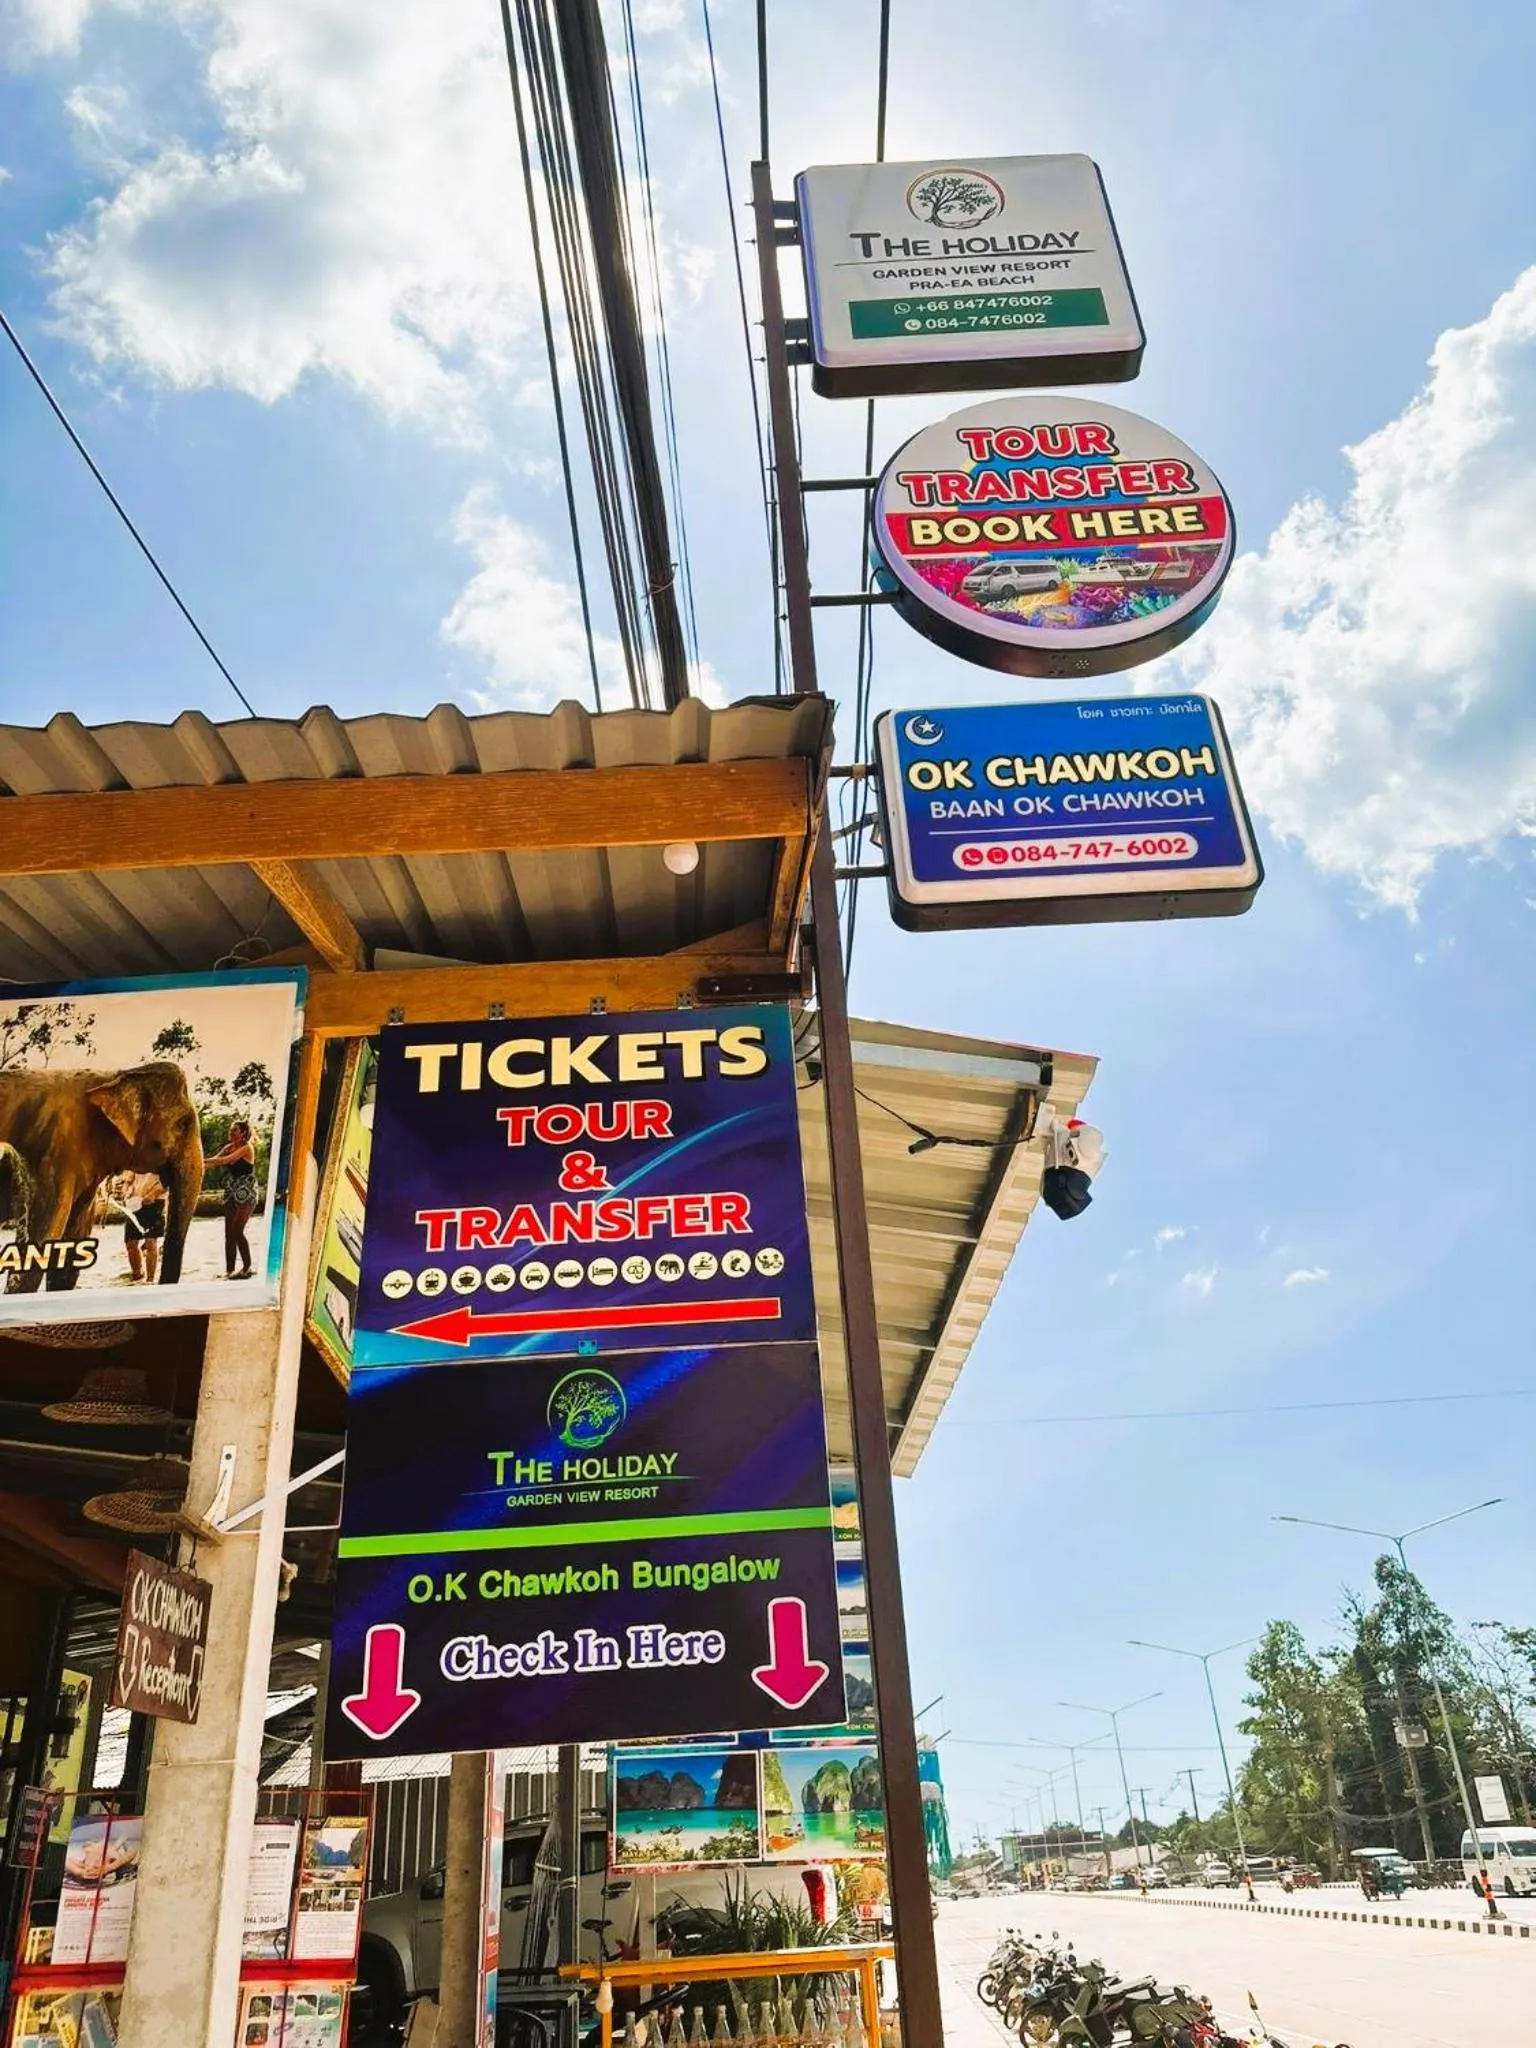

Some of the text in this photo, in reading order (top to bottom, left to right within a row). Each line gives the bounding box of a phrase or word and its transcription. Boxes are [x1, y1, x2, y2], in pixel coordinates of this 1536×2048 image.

[849, 230, 1081, 259] THE HOLIDAY
[873, 259, 1072, 280] GARDEN VIEW RESORT
[909, 274, 1035, 291] PRA-EA BEACH
[915, 295, 1054, 314] +66 847476002
[925, 312, 1047, 330] 084-7476002
[958, 422, 1118, 460] TOUR
[899, 460, 1198, 506] TRANSFER
[909, 505, 1205, 546] BOOK HERE
[907, 745, 1218, 792] OK CHAWKOH
[929, 787, 1206, 820] BAAN OK CHAWKOH
[1011, 837, 1190, 863] 084-747-6002
[404, 1026, 768, 1094] TICKETS
[496, 1099, 674, 1147] TOUR
[558, 1151, 616, 1192] &
[415, 1191, 755, 1253] TRANSFER
[487, 1450, 679, 1486] THE HOLIDAY
[506, 1485, 660, 1508] GARDEN VIEW RESORT
[407, 1554, 781, 1604] O.K Chawkoh Bungalow
[138, 1635, 189, 1707] Reception
[440, 1624, 726, 1682] Check In Here
